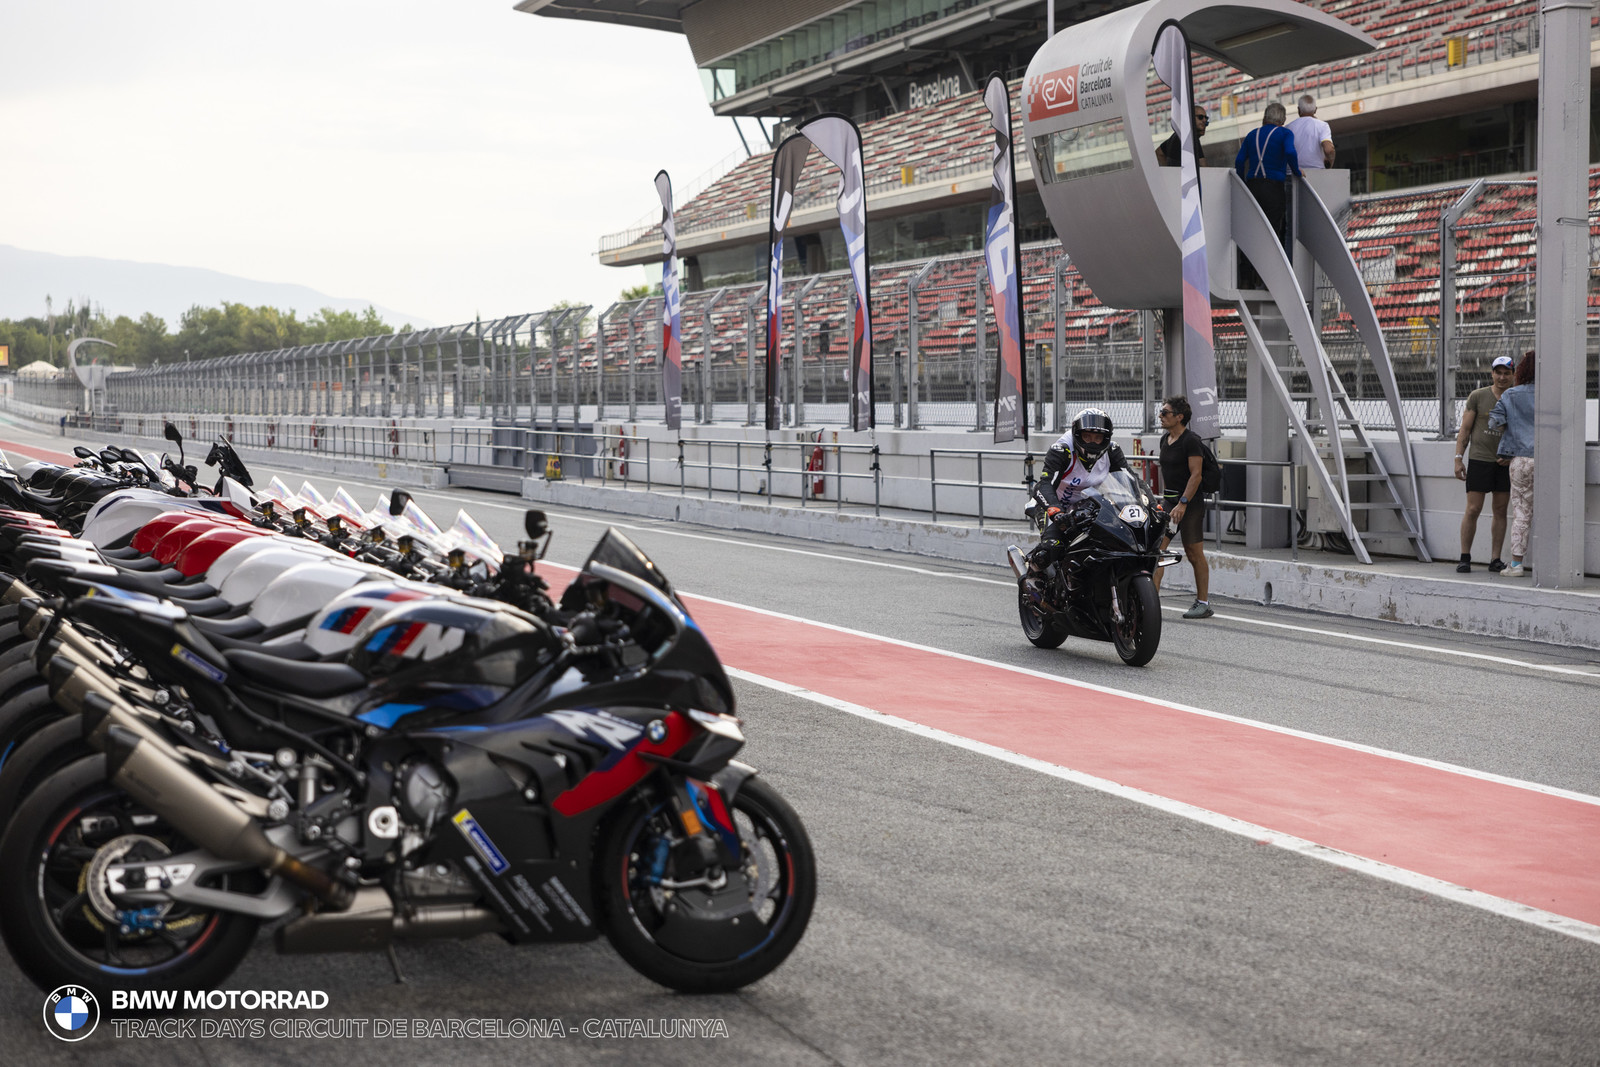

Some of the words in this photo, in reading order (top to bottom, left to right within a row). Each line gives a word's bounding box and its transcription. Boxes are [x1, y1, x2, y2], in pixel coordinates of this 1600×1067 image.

[1081, 58, 1103, 77] Circuit
[1103, 57, 1113, 71] de
[909, 74, 961, 109] Barcelona
[1080, 76, 1112, 94] Barcelona
[1080, 92, 1114, 110] CATALUNYA
[1128, 508, 1140, 519] 27
